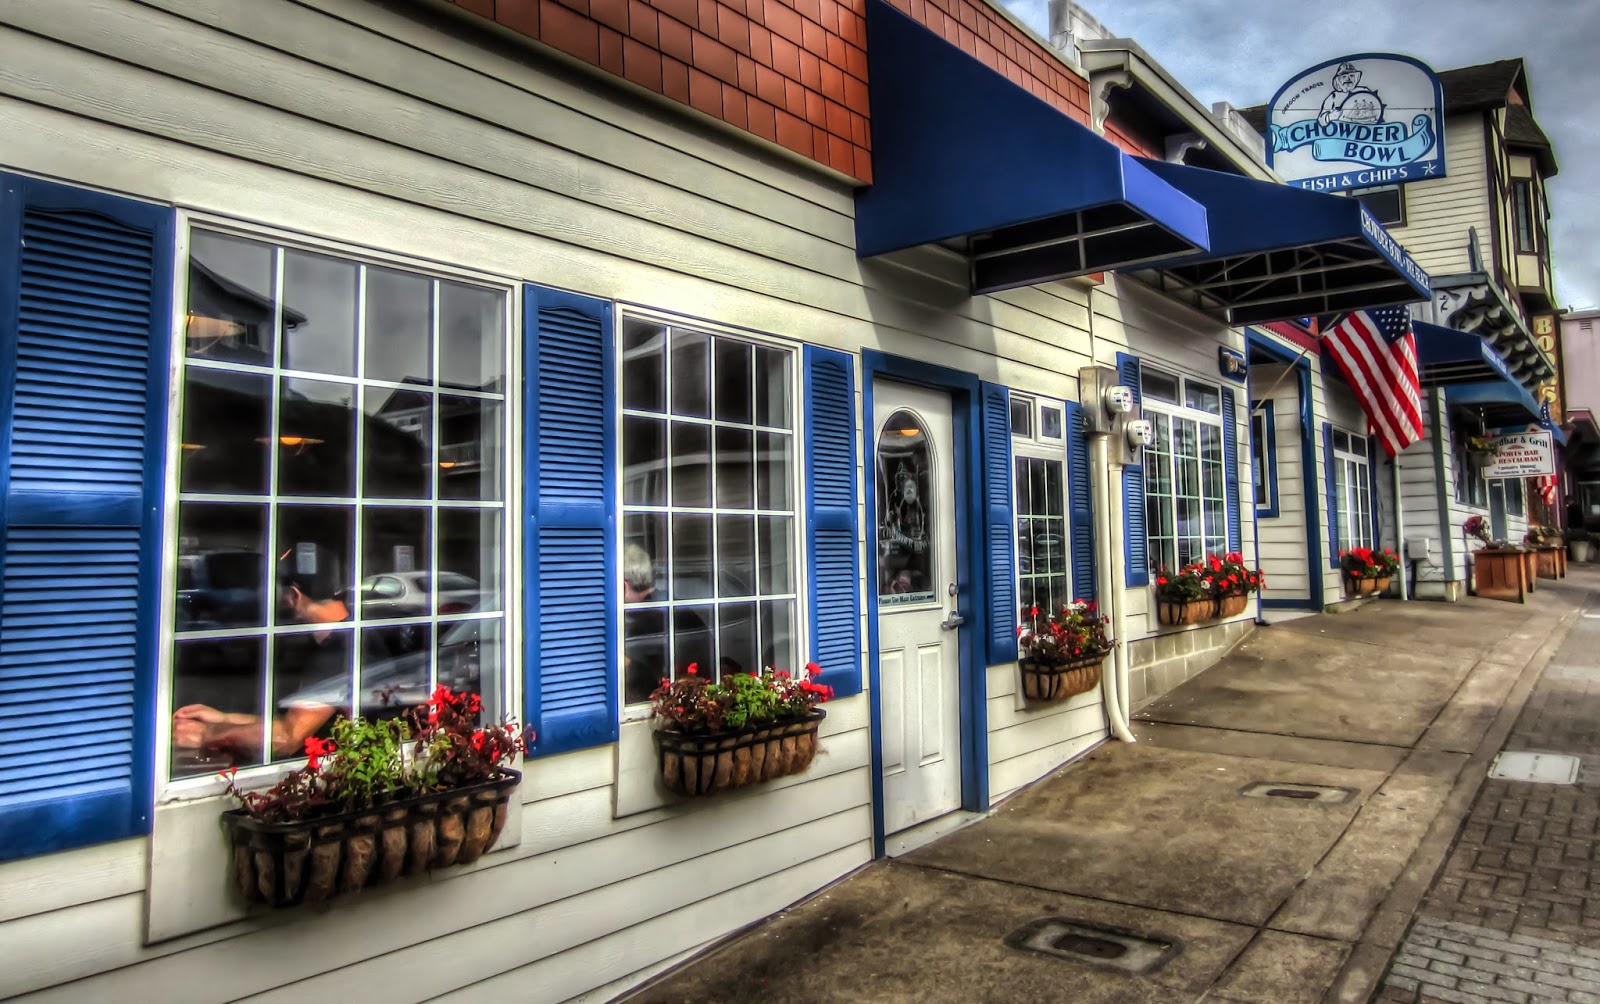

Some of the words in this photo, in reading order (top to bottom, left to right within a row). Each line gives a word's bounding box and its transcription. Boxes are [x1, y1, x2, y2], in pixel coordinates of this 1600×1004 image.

[1281, 94, 1300, 115] OREGON
[1290, 122, 1400, 143] CHOWDER
[1343, 142, 1412, 163] BOWL
[1302, 175, 1337, 190] FISH
[1341, 175, 1353, 186] &
[1357, 166, 1408, 184] CHIPS
[1529, 437, 1548, 448] Grill
